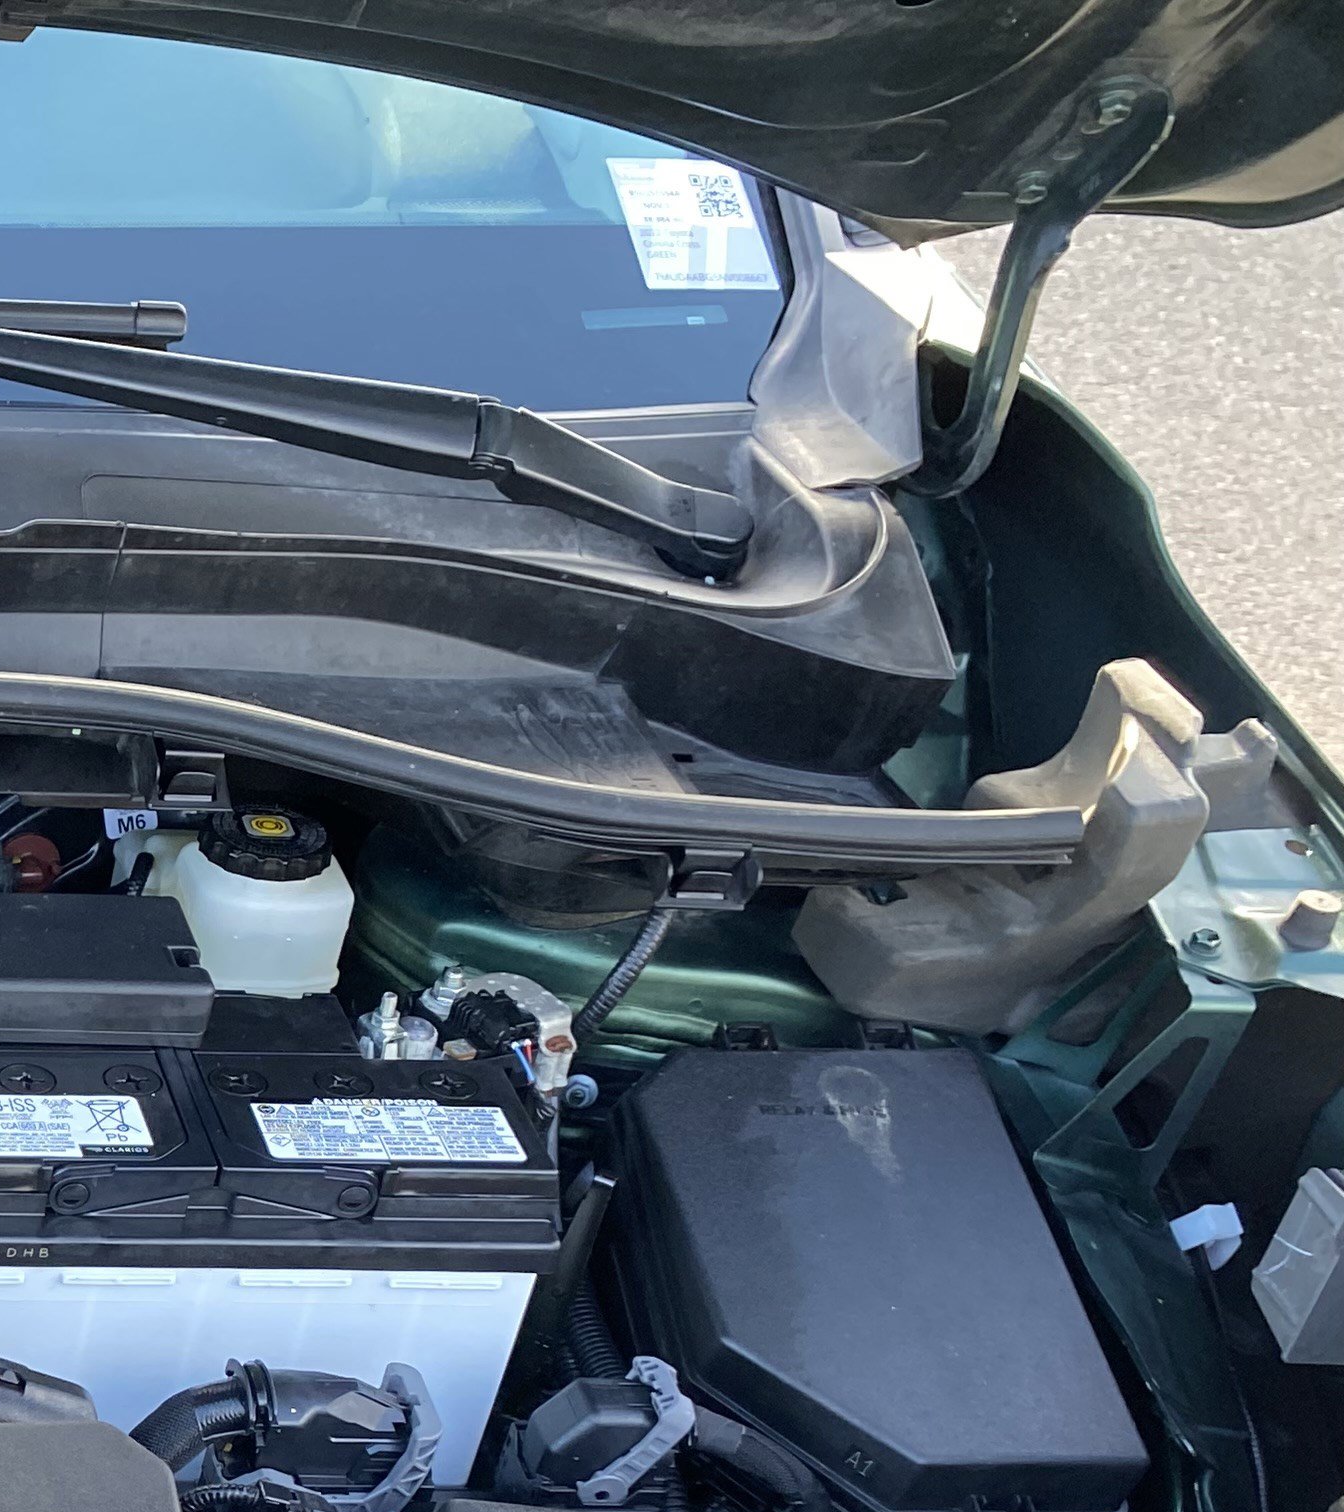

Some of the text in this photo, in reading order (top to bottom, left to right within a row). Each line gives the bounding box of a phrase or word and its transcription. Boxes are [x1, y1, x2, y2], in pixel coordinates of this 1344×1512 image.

[117, 814, 147, 834] M6
[322, 1098, 438, 1107] DANGER/POISON
[0, 1122, 18, 1131] CCA
[47, 1123, 71, 1132] (SAE)
[106, 1133, 128, 1142] Pb
[844, 1451, 874, 1477] A1
